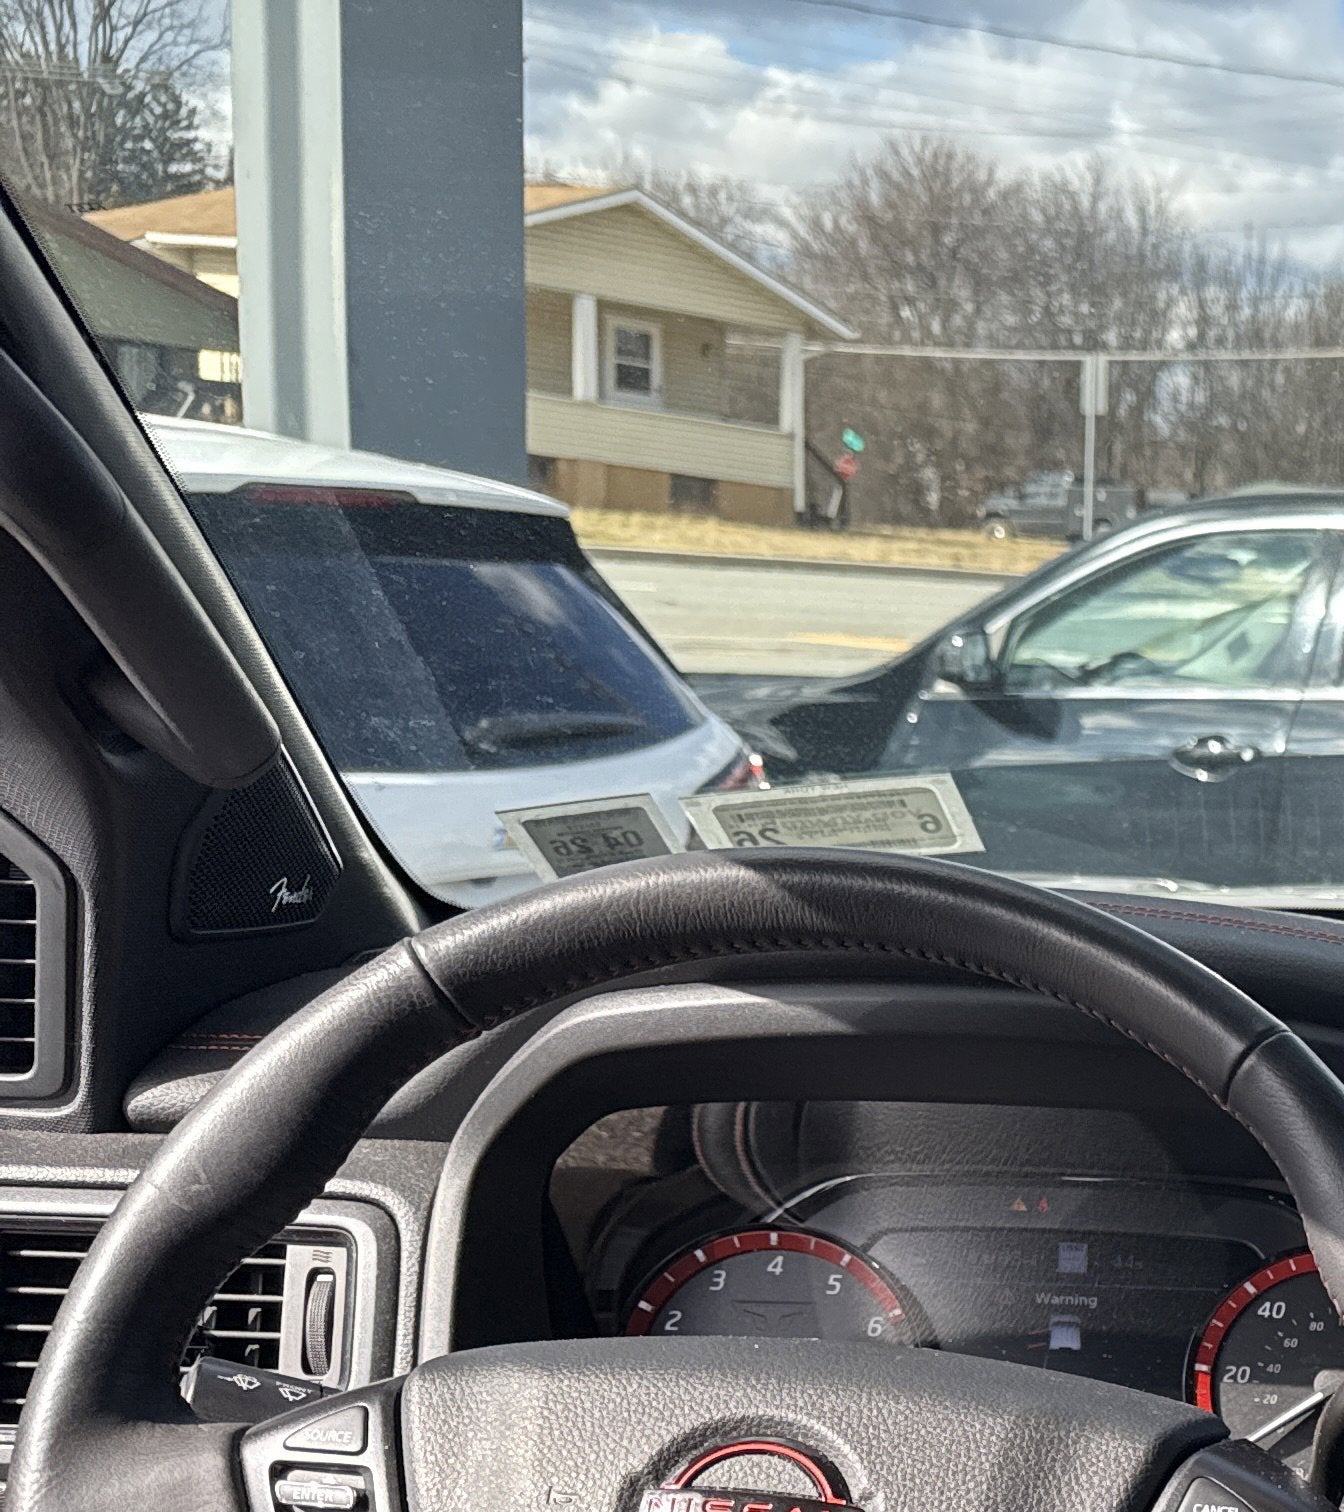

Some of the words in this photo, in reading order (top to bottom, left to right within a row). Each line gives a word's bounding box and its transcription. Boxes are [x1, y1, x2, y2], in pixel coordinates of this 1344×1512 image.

[766, 1255, 785, 1276] 4
[708, 1269, 728, 1291] 3
[825, 1274, 844, 1295] 5
[1035, 1291, 1099, 1309] Warning
[1257, 1301, 1287, 1319] 40
[663, 1310, 683, 1331] 2
[867, 1316, 885, 1337] 6
[1309, 1321, 1325, 1332] 80
[1283, 1338, 1299, 1349] 60
[1222, 1366, 1251, 1384] 20
[1266, 1363, 1282, 1374] 40
[1262, 1394, 1279, 1405] 20
[300, 1428, 353, 1443] SOURCE
[292, 1487, 335, 1502] ENTER
